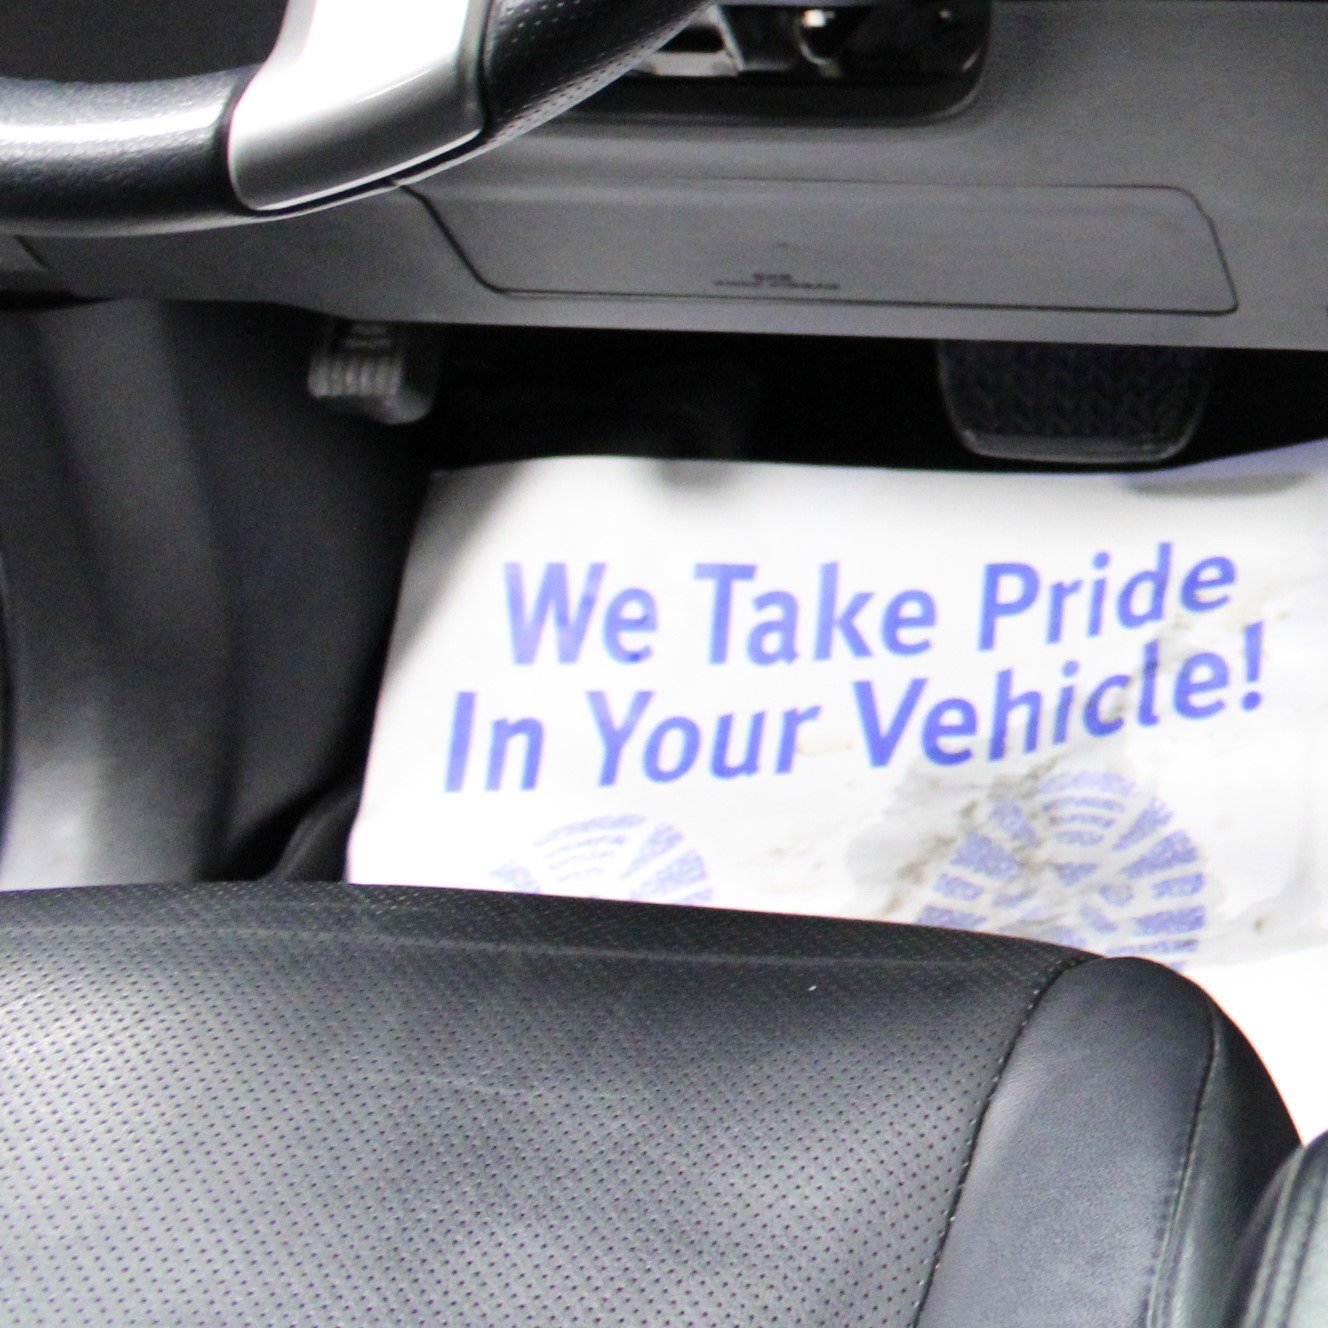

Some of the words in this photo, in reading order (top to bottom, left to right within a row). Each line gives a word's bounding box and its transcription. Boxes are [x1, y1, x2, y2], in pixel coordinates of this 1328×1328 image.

[503, 561, 659, 667] We
[694, 561, 938, 667] Take
[976, 542, 1238, 654] Pride
[443, 690, 546, 793] In
[586, 690, 820, 788] Your
[851, 621, 1266, 770] Vehicle!
